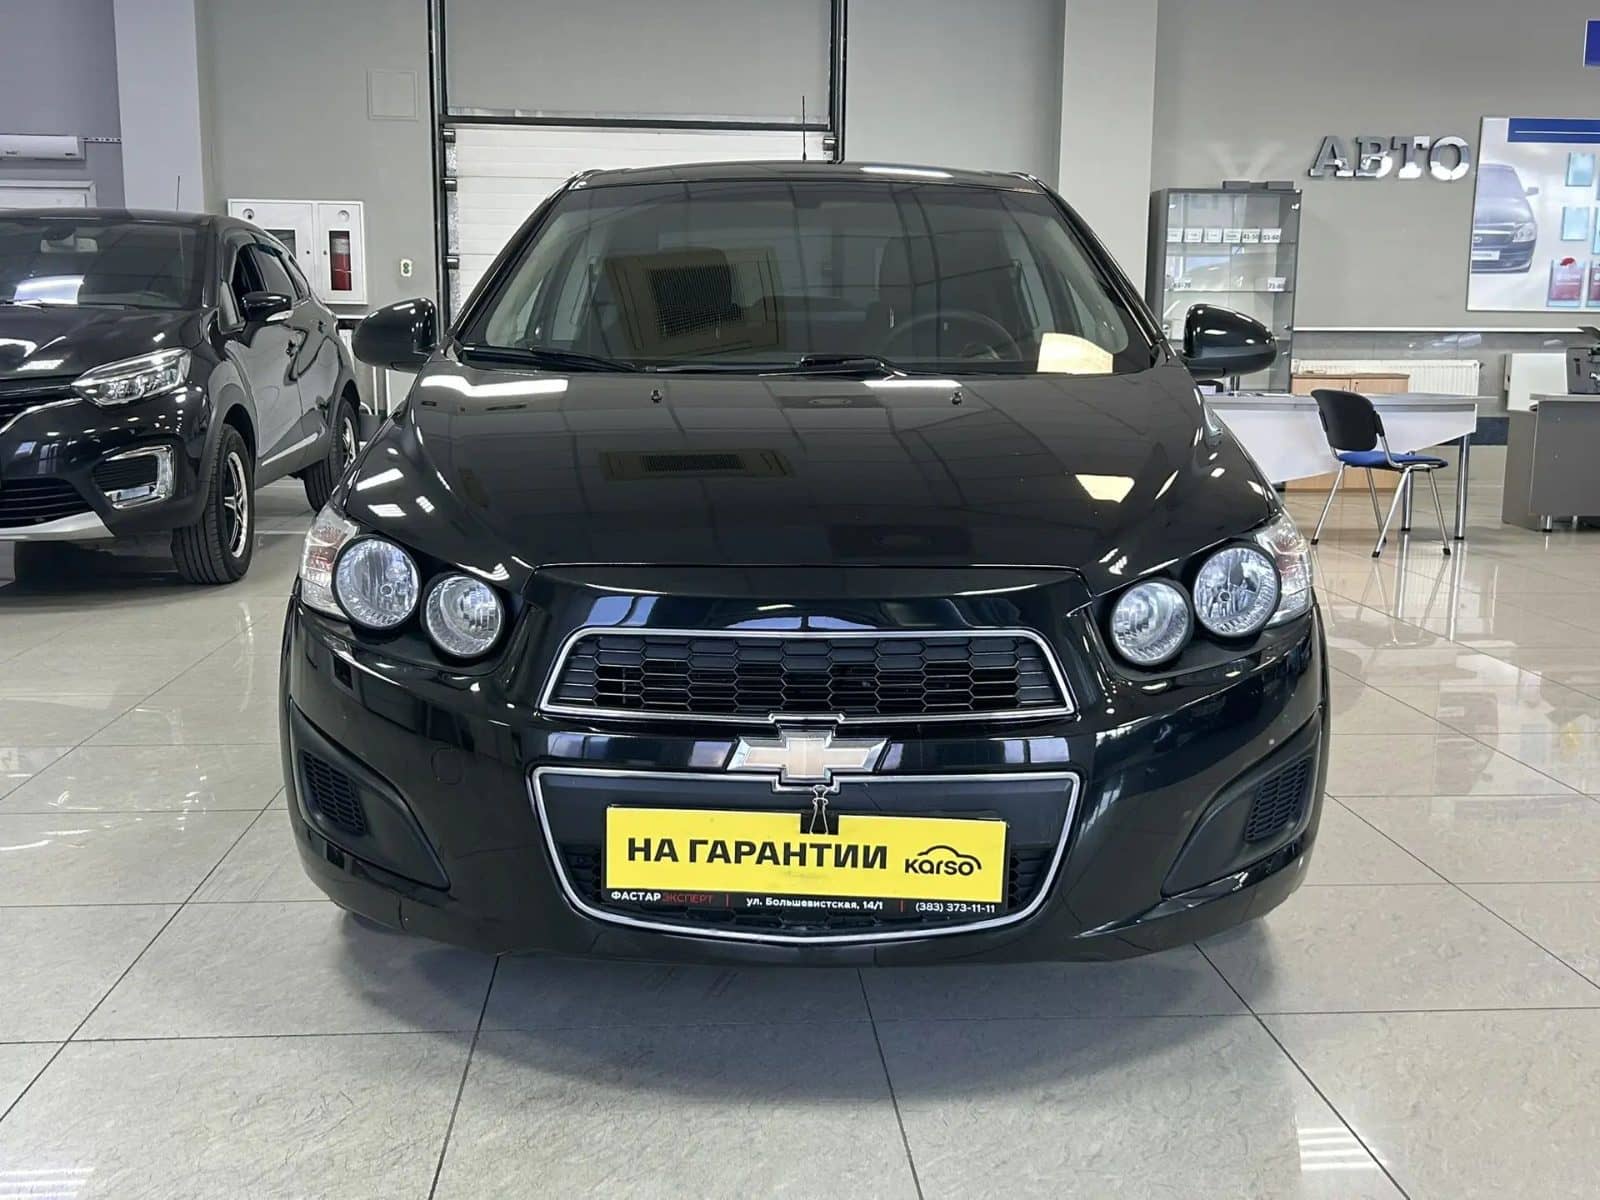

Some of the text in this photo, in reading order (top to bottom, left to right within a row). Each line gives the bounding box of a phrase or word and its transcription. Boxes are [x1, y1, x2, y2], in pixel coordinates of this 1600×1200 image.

[1308, 135, 1470, 181] АВТО
[627, 837, 888, 870] НА ГАРАНТИИ
[746, 897, 763, 907] ул.
[862, 900, 883, 911] 14/1
[915, 902, 944, 912] (383)
[946, 903, 996, 914] 373-11-11
